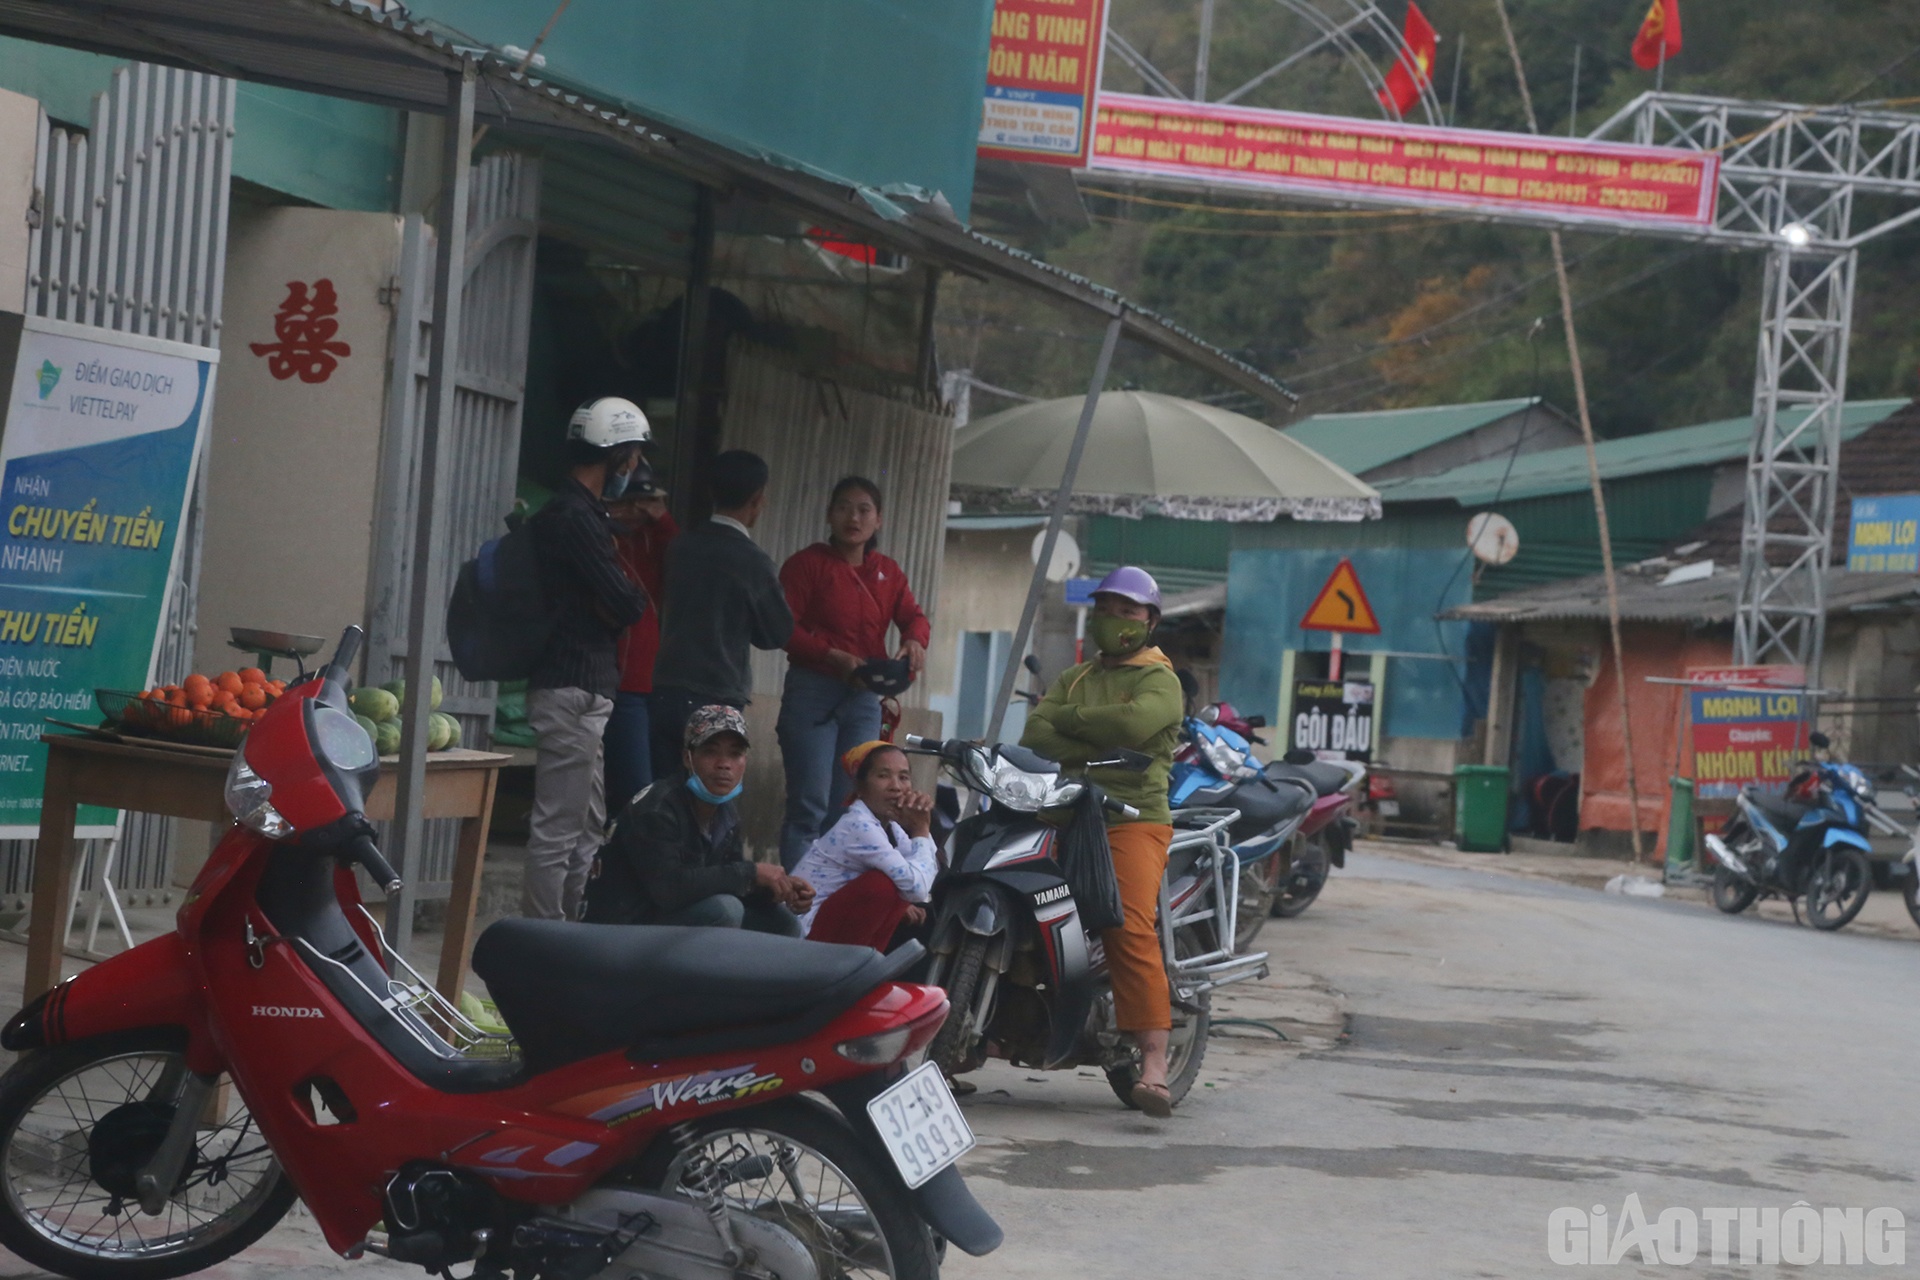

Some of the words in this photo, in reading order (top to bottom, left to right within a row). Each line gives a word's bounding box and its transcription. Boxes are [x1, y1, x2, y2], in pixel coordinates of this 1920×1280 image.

[1037, 14, 1087, 46] VINH
[988, 44, 1022, 78] ÔN
[1028, 50, 1079, 84] NĂM
[75, 359, 108, 385] ĐIỂM
[110, 368, 142, 390] GIAO
[142, 373, 174, 397] DỊCH
[70, 395, 139, 422] VIETTELPAY
[15, 475, 50, 499] NHẬN
[8, 498, 109, 543] CHUYỂN
[112, 506, 164, 549] TIỀN
[2, 545, 63, 574] NHANH
[43, 602, 99, 646] TIỀN
[27, 657, 62, 678] NƯỚC
[13, 689, 38, 711] GÓP,
[39, 688, 64, 709] BẢO
[64, 688, 92, 710] HIỂM
[1702, 696, 1762, 722] MẠNH
[12, 722, 46, 744] THOẠI
[1696, 745, 1757, 779] NHÔM
[1034, 884, 1071, 905] YAMAHA
[251, 1005, 325, 1018] HONDA
[649, 1072, 776, 1110] Wave
[697, 1093, 732, 1105] HONDA
[734, 1078, 783, 1099] 110
